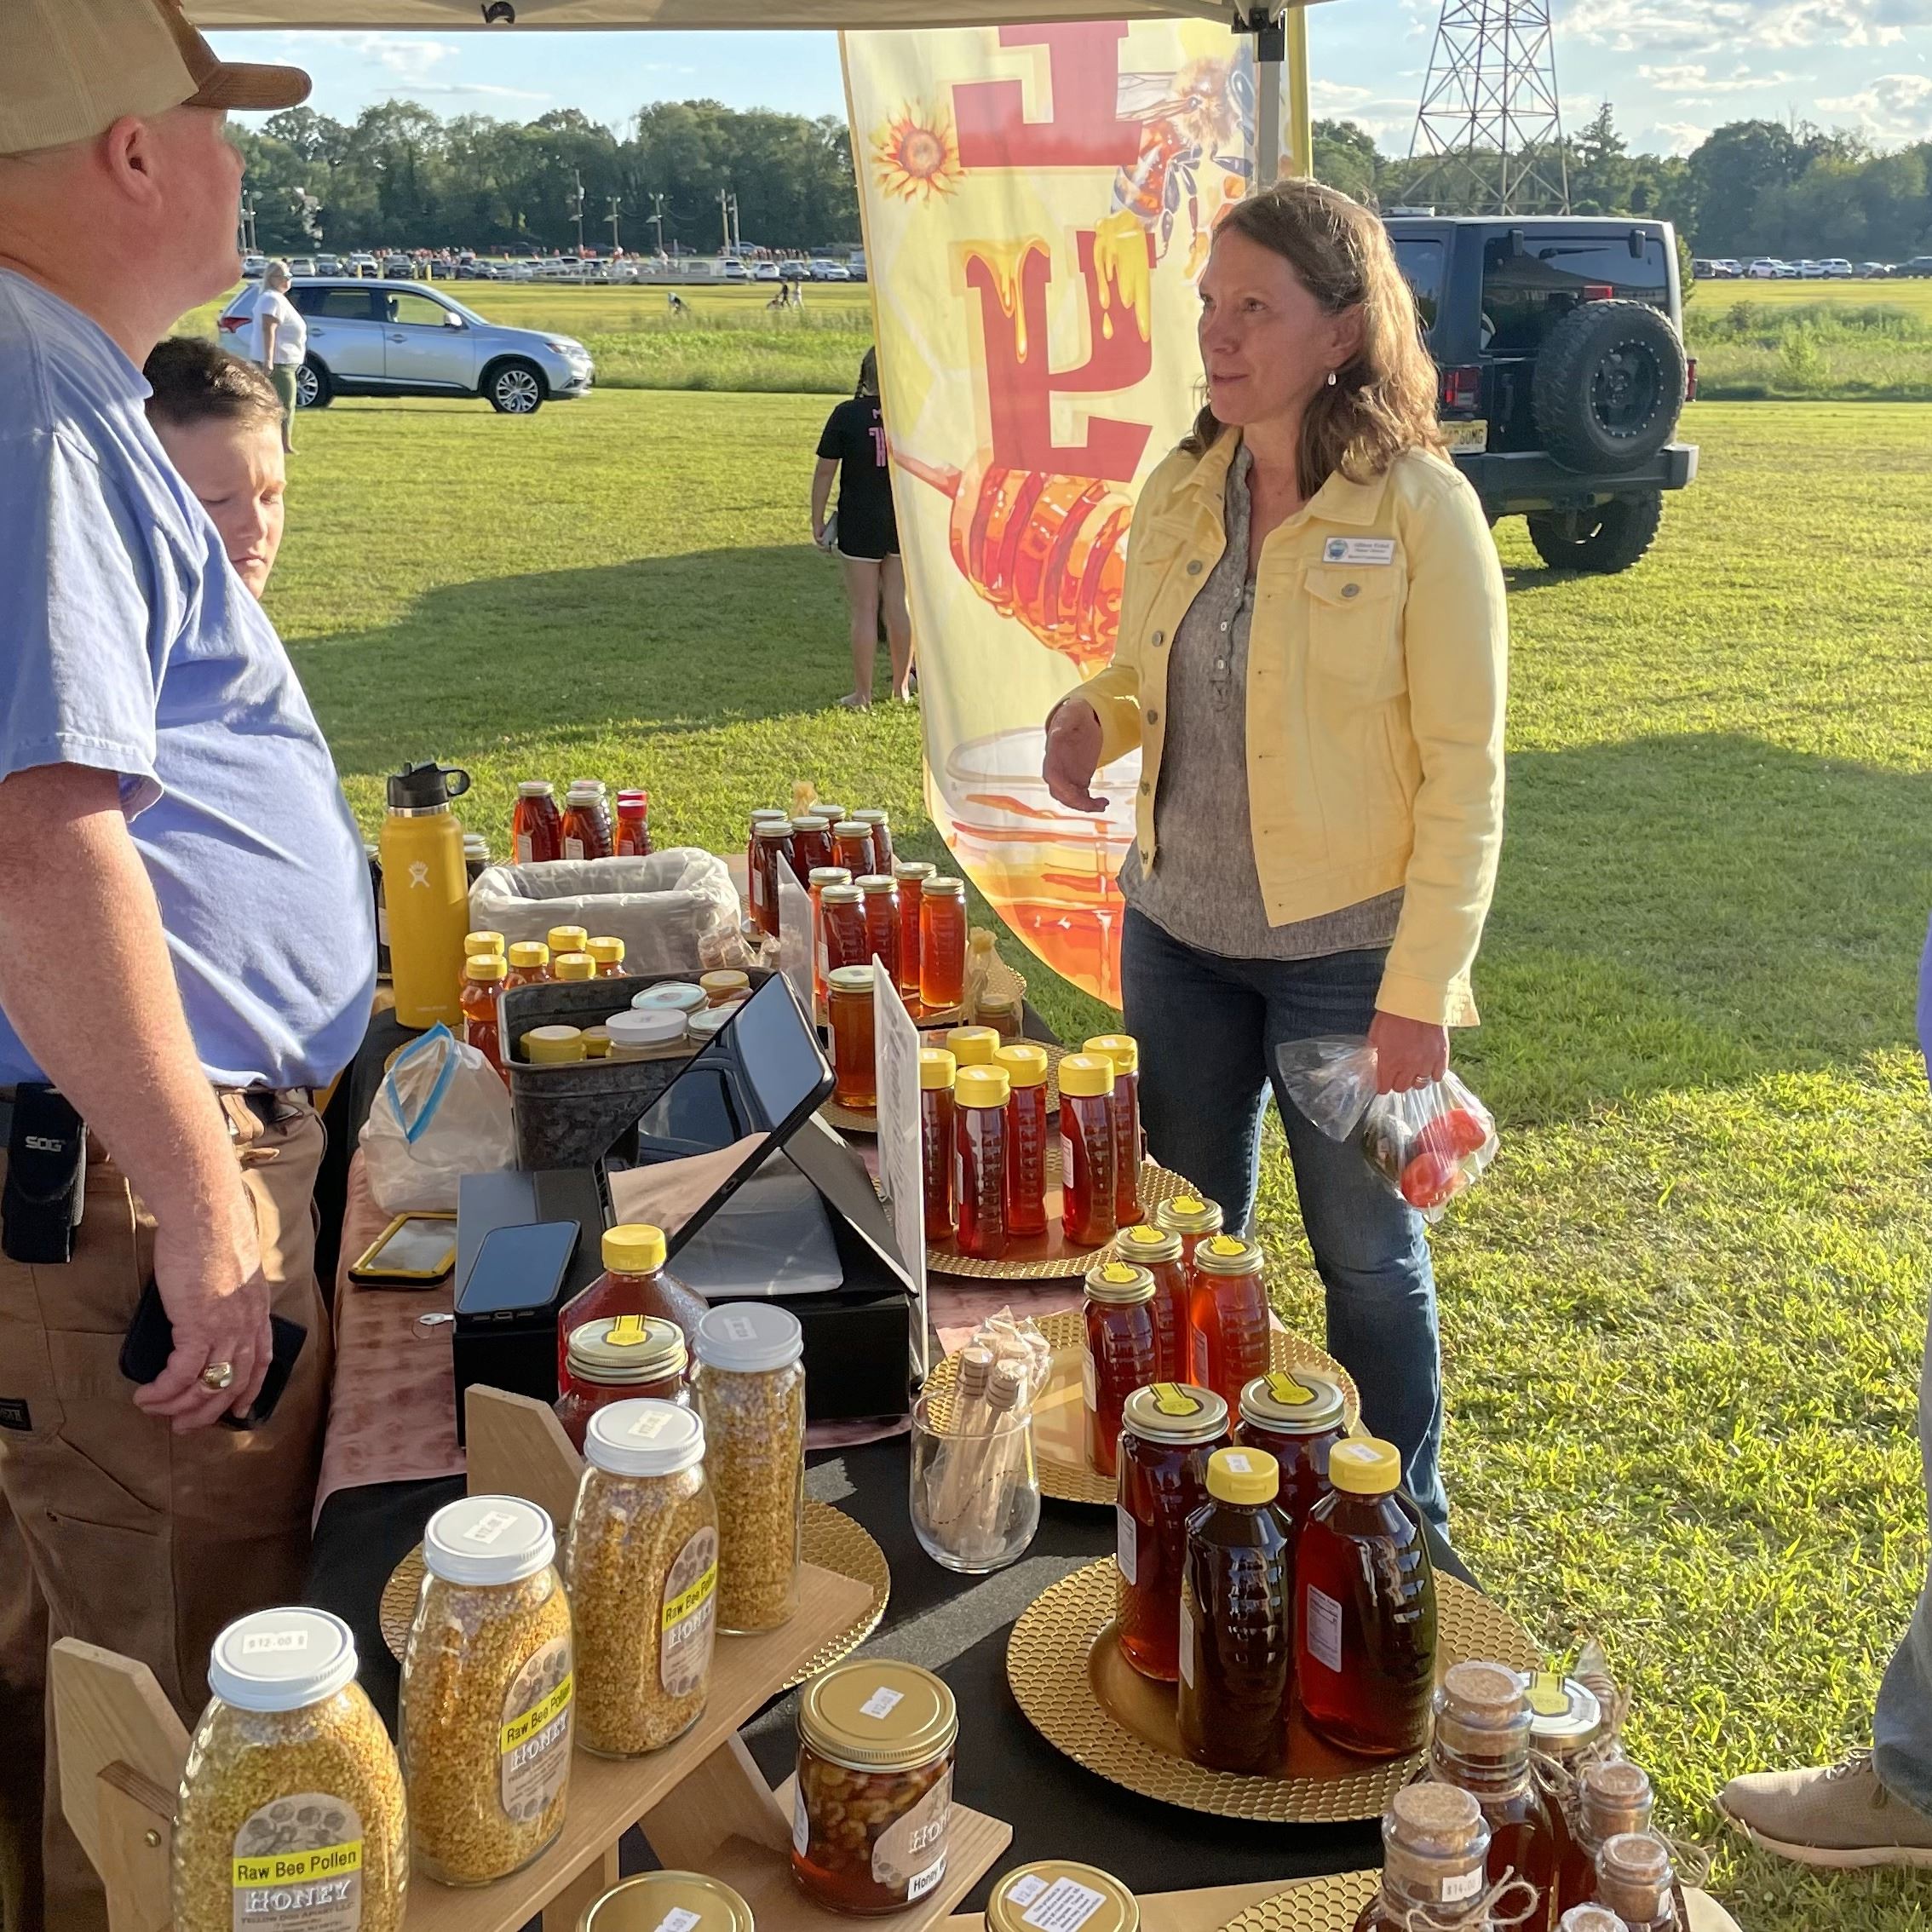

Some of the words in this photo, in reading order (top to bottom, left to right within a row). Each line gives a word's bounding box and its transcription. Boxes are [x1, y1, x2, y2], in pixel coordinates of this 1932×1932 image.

[26, 1136, 62, 1153] SOG
[507, 1722, 528, 1745] Raw
[531, 1706, 549, 1729] Bee
[510, 1710, 569, 1773] HONEY
[238, 1865, 271, 1882] Raw
[275, 1861, 305, 1878] Bee
[310, 1850, 356, 1872] Pollen
[245, 1879, 352, 1912] HONEY
